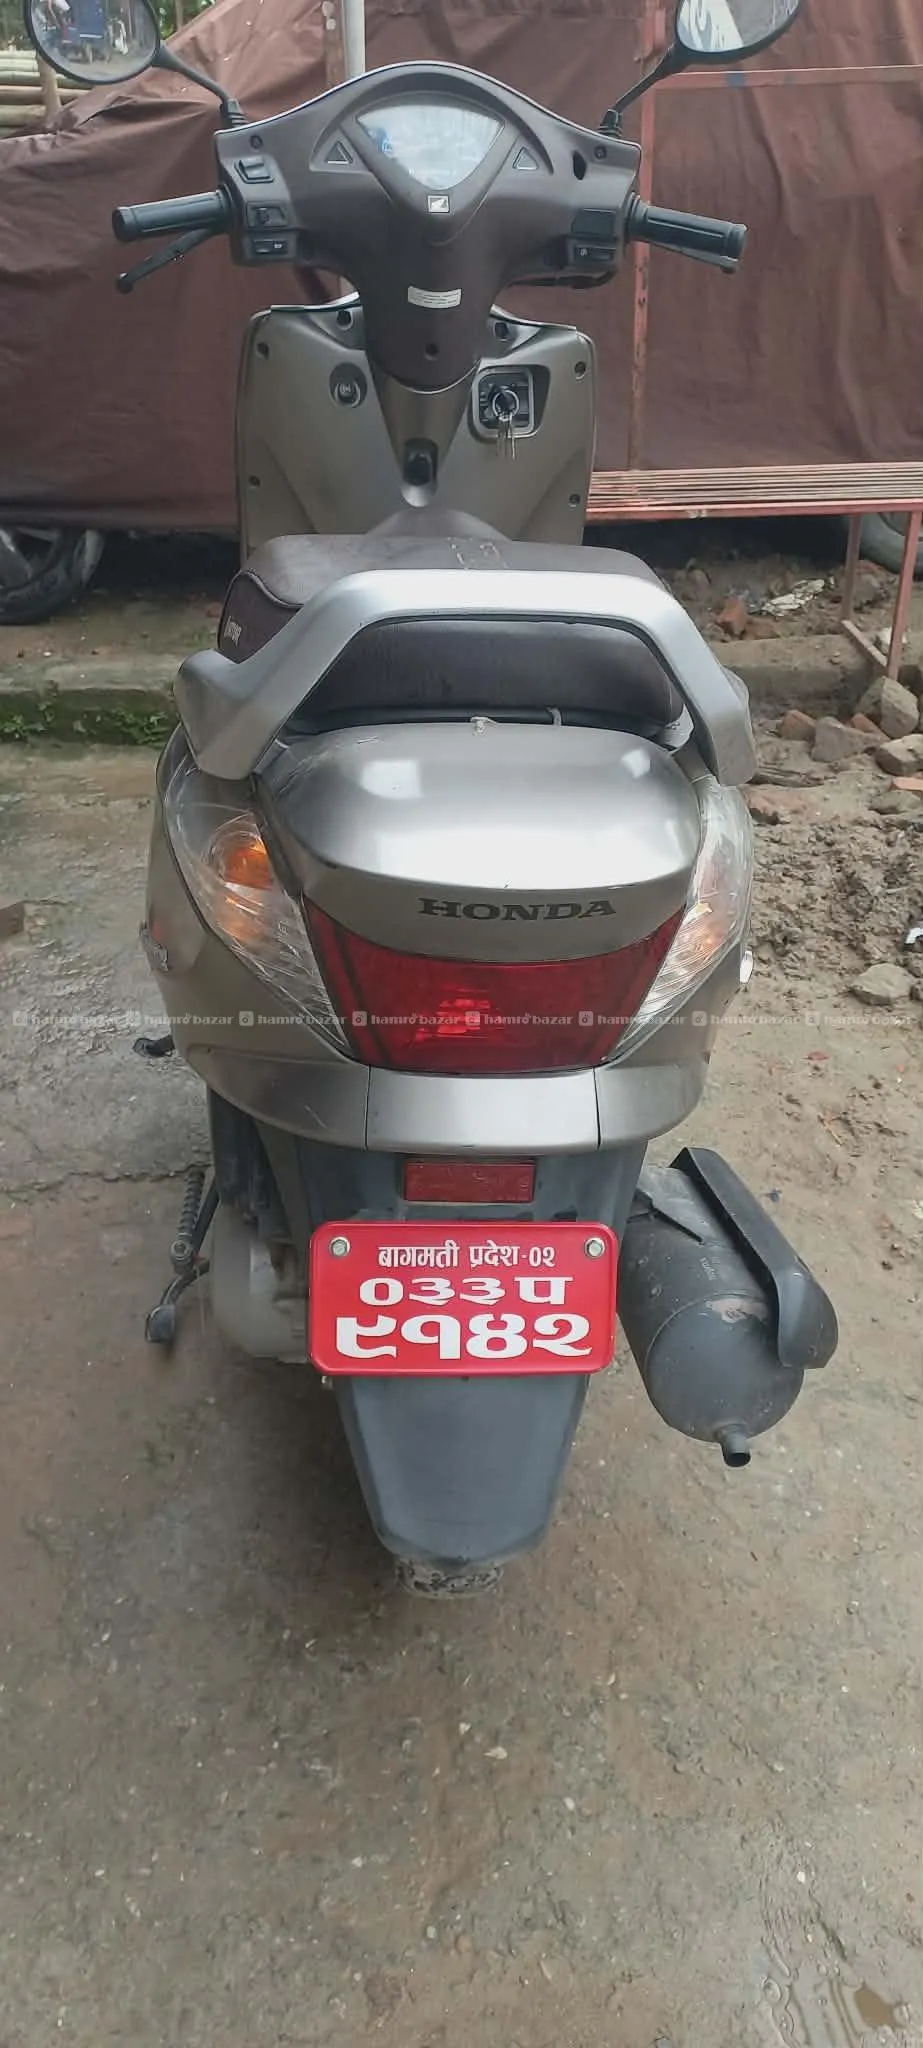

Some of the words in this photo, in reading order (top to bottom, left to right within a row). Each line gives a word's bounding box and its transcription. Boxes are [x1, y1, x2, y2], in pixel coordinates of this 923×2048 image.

[418, 898, 617, 921] HONDA
[378, 1240, 460, 1268] बागमती
[335, 1313, 593, 1360] ९१४२
